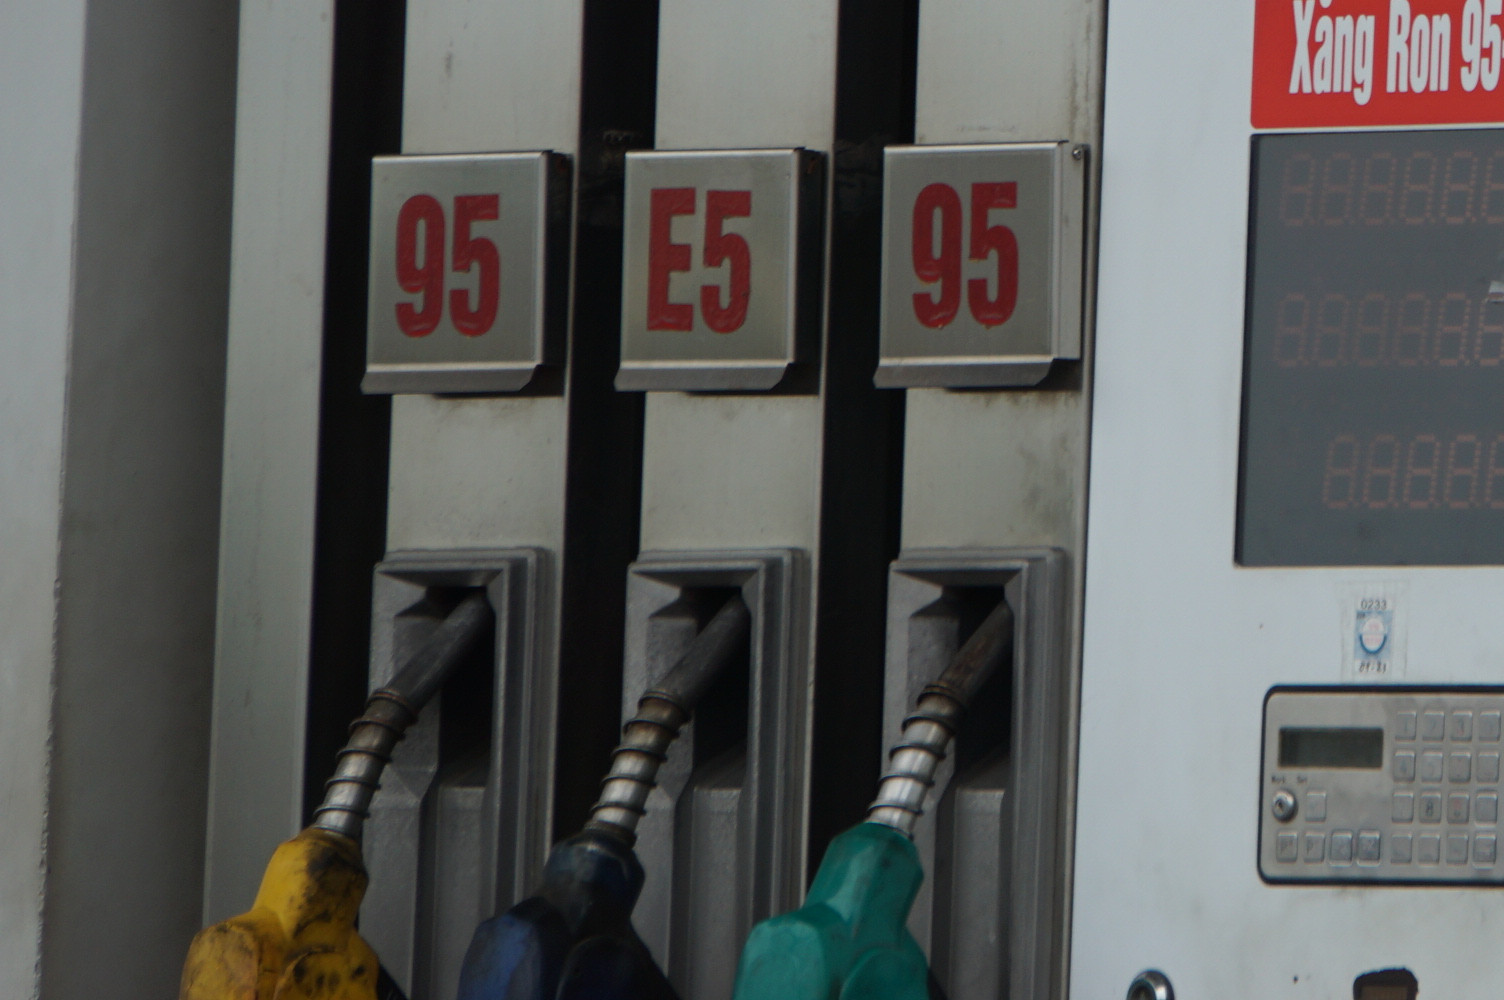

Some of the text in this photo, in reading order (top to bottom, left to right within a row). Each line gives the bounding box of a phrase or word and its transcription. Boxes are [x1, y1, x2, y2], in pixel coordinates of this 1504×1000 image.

[395, 193, 500, 338] 95
[646, 187, 752, 335] E5
[911, 181, 1018, 329] 95
